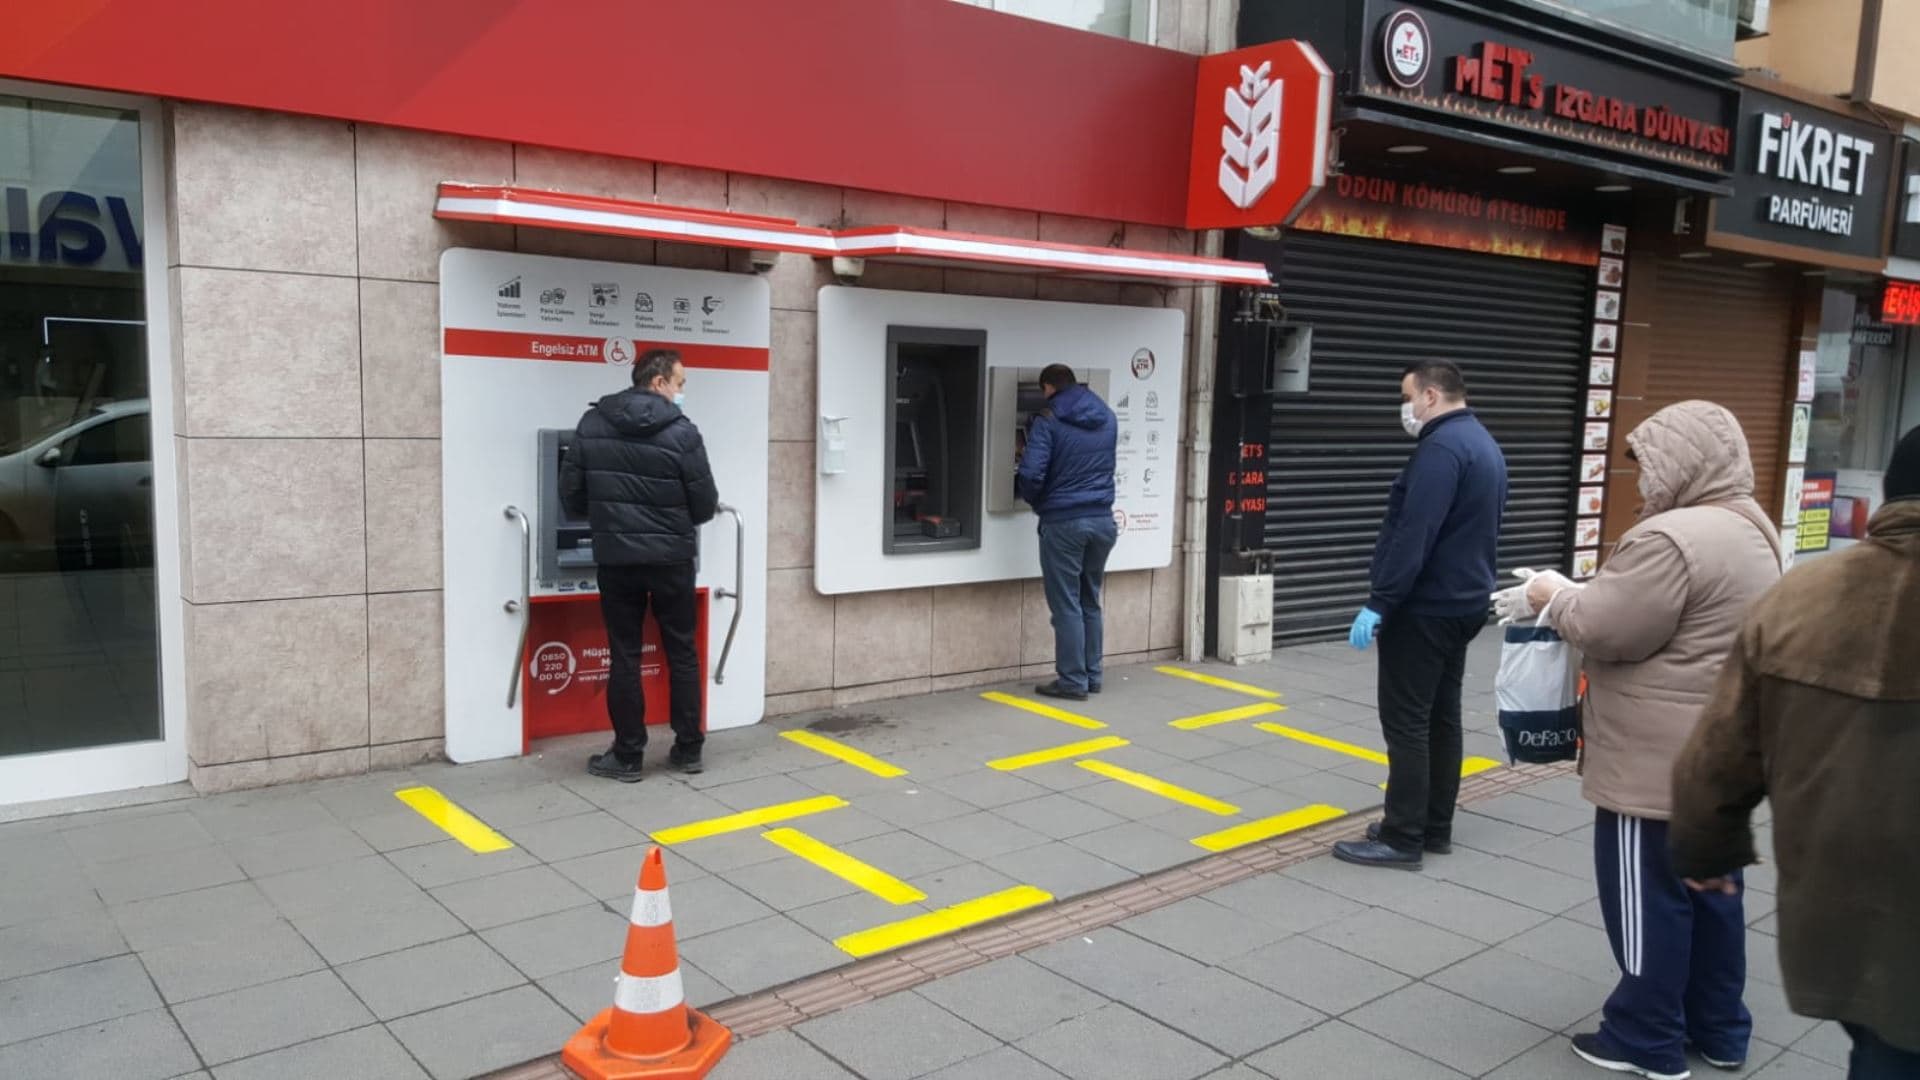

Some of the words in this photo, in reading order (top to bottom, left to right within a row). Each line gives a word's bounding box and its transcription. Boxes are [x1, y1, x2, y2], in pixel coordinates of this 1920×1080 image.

[1555, 83, 1637, 134] IZGARA
[1643, 103, 1731, 156] DÜNYASI
[1757, 111, 1875, 196] FİKRET
[1337, 174, 1397, 204] ODUN
[1402, 182, 1482, 218] KÖMÜRÜ
[1768, 194, 1854, 236] PARFÜMERİ
[532, 340, 574, 357] Engelsiz
[576, 344, 599, 356] ATM
[544, 662, 563, 671] 220
